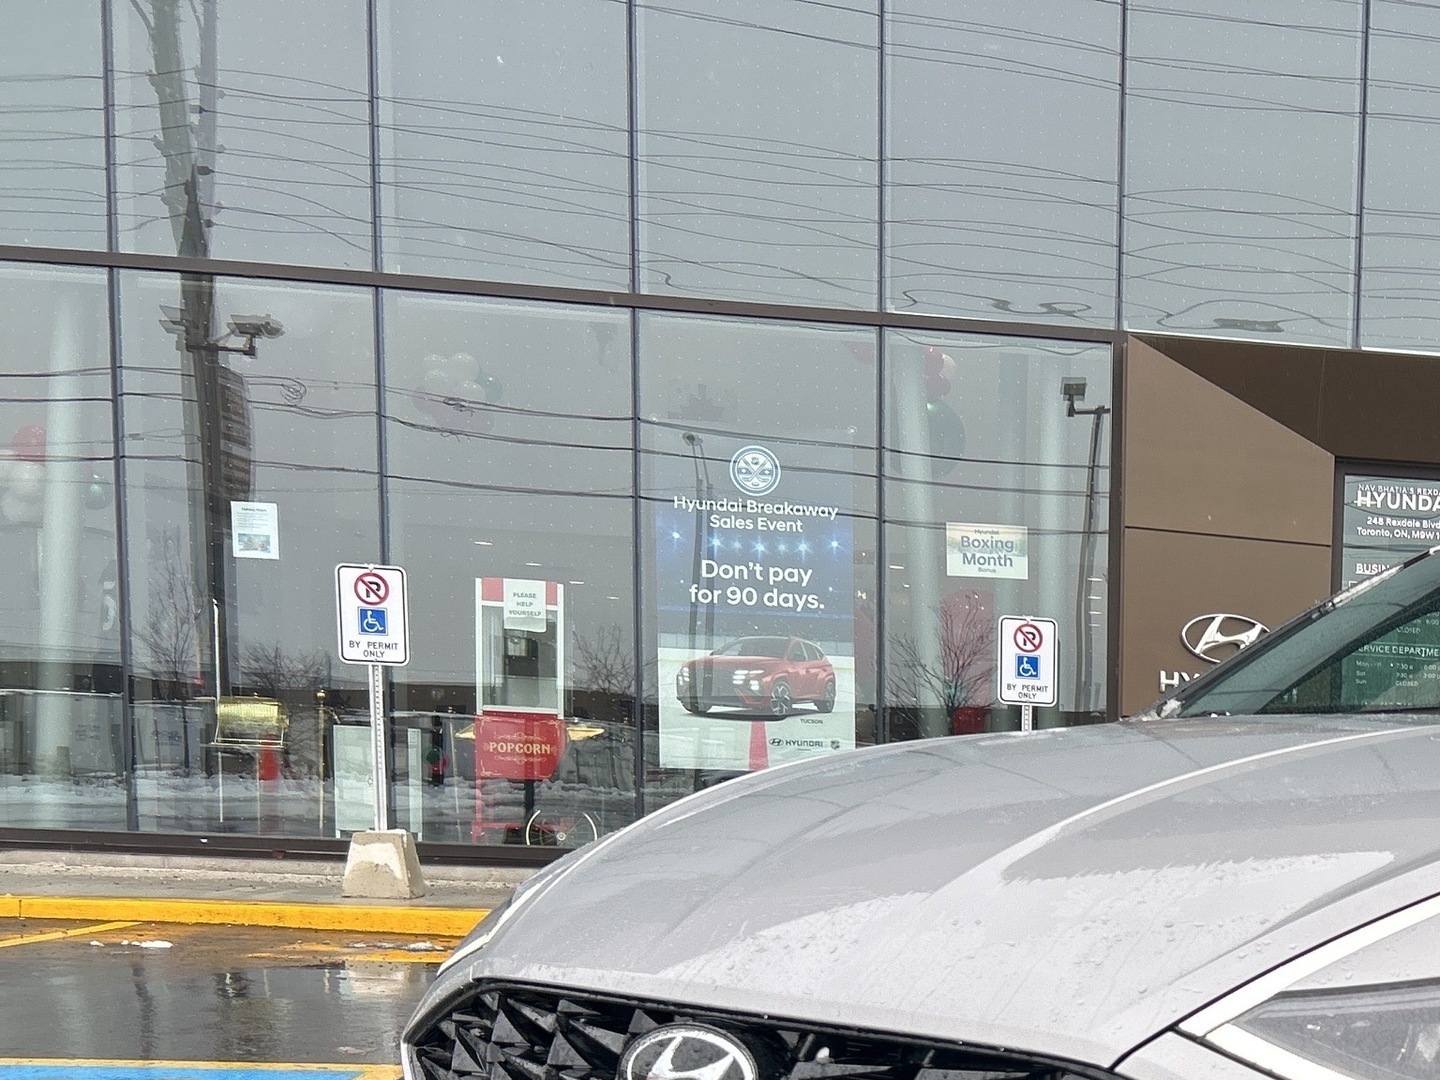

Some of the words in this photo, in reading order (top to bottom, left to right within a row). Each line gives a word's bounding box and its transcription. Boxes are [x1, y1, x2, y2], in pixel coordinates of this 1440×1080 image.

[1358, 484, 1375, 492] NAV
[1378, 485, 1414, 495] BHATIA'S
[673, 495, 742, 513] Hyundai
[746, 499, 839, 520] Breakaway
[709, 515, 754, 530] Sales
[757, 517, 803, 533] Event
[1386, 517, 1420, 528] Rexdale
[1357, 526, 1393, 538] Toronto,
[1394, 529, 1411, 539] ON,
[1412, 530, 1434, 540] M9W
[960, 535, 1014, 553] Boxing
[962, 553, 1013, 568] Month
[701, 559, 764, 581] Don't
[768, 565, 813, 587] pay
[689, 583, 722, 604] for
[726, 586, 757, 606] 90
[763, 588, 825, 612] days.
[349, 640, 361, 649] BY
[367, 641, 399, 651] PERMIT
[363, 649, 385, 658] ONLY
[1006, 683, 1017, 691] BY
[1021, 684, 1049, 693] PERMIT
[1018, 692, 1037, 700] ONLY
[488, 741, 551, 755] POPCORN
[785, 739, 824, 748] HYUNDAI
